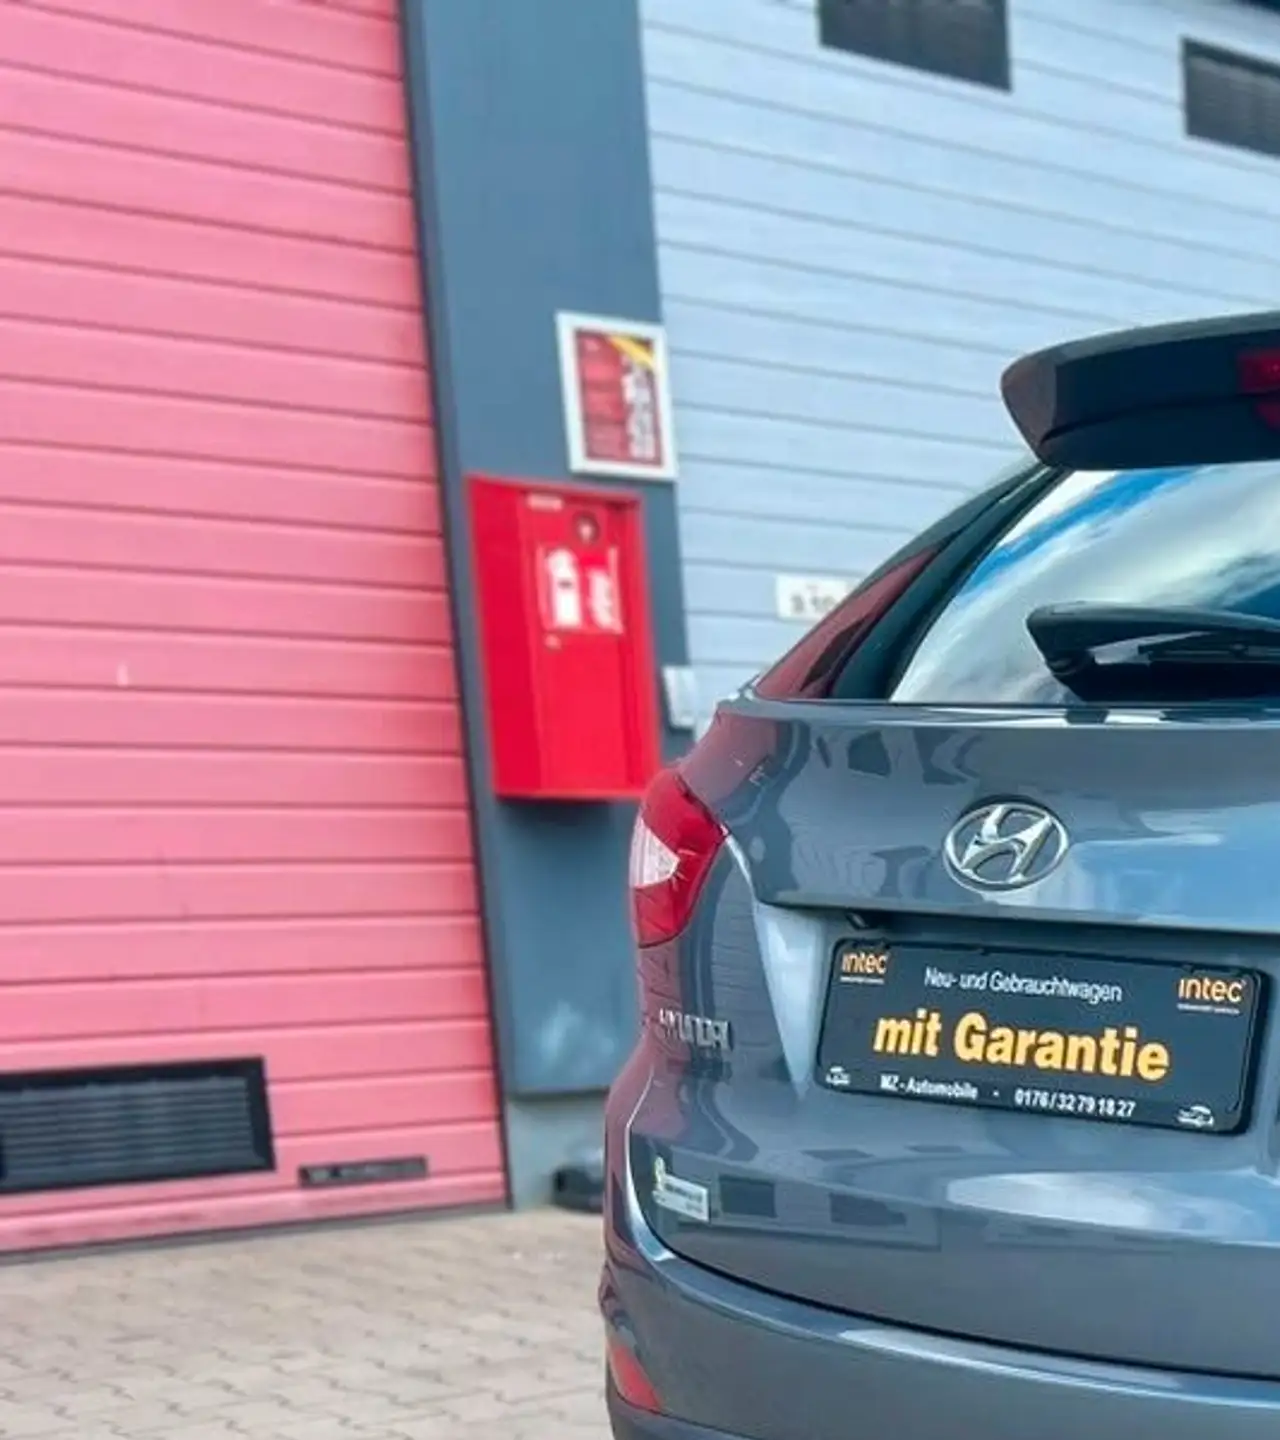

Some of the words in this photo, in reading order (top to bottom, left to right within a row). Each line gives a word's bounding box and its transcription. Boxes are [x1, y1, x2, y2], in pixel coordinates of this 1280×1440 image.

[841, 953, 888, 974] intec
[924, 966, 957, 988] Neu-
[959, 971, 988, 991] und
[989, 970, 1123, 1005] Gebrauchtwagen
[1178, 977, 1242, 1003] intec
[873, 1007, 942, 1056] mit
[953, 1011, 1169, 1081] Garantie
